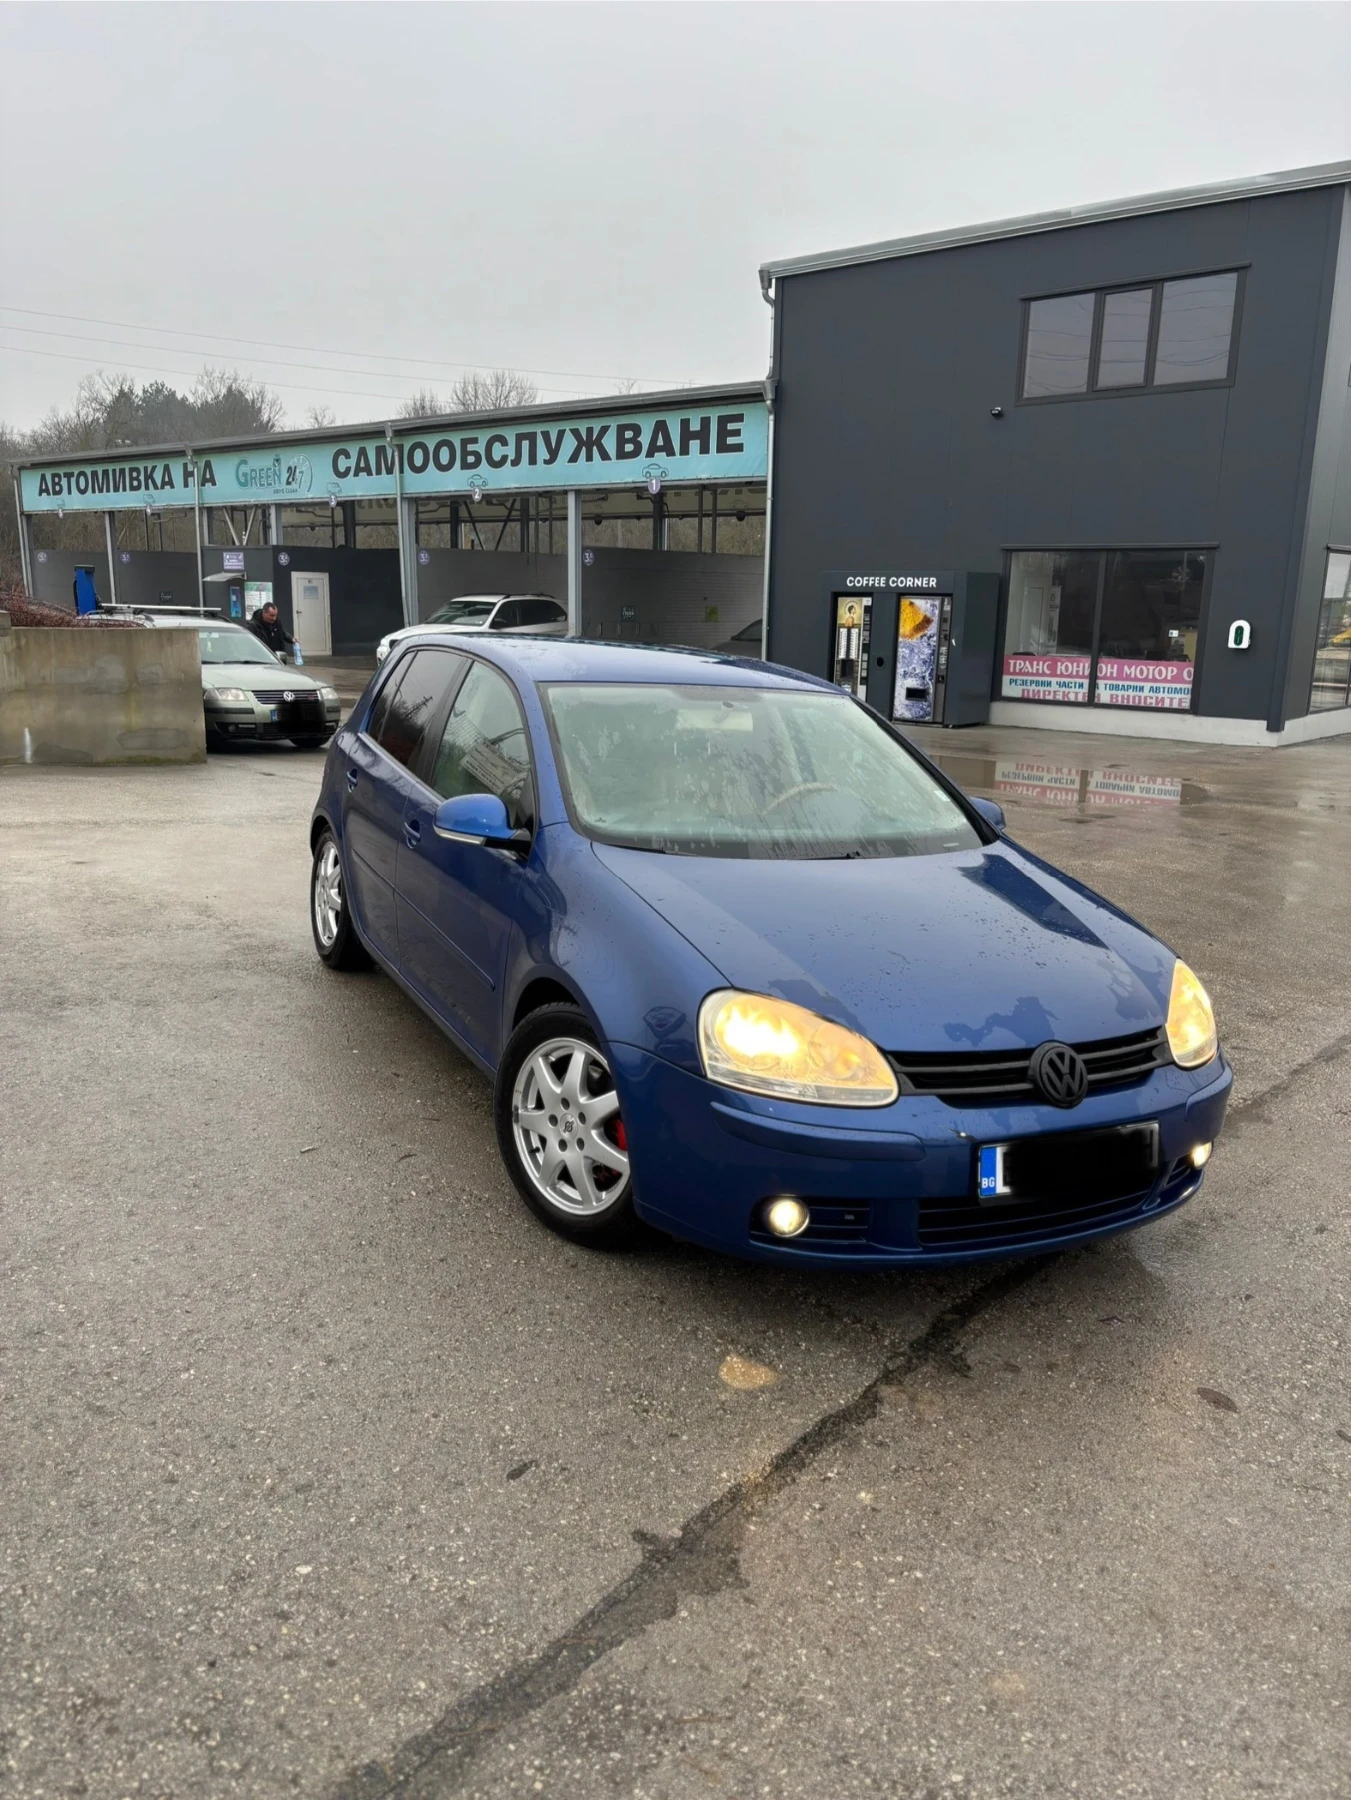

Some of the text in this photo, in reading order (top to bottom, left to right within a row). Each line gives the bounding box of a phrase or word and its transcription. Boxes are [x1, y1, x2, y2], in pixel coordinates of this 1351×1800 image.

[331, 413, 745, 479] САМООБСЛУЖВАНЕ
[38, 459, 217, 497] АВТОМИВКА НА
[846, 576, 937, 588] COFFEE CORNER
[1008, 659, 1052, 675] ТРАНС
[1123, 664, 1178, 680] МОТОР
[1009, 678, 1052, 688] РЕЗЕРВНИ
[1056, 681, 1084, 690] ЧАСТИ
[1104, 683, 1145, 693] ТОВАРНИ
[1148, 685, 1192, 695] АВТОМО
[1042, 1047, 1085, 1105] VW
[981, 1178, 995, 1188] BG
